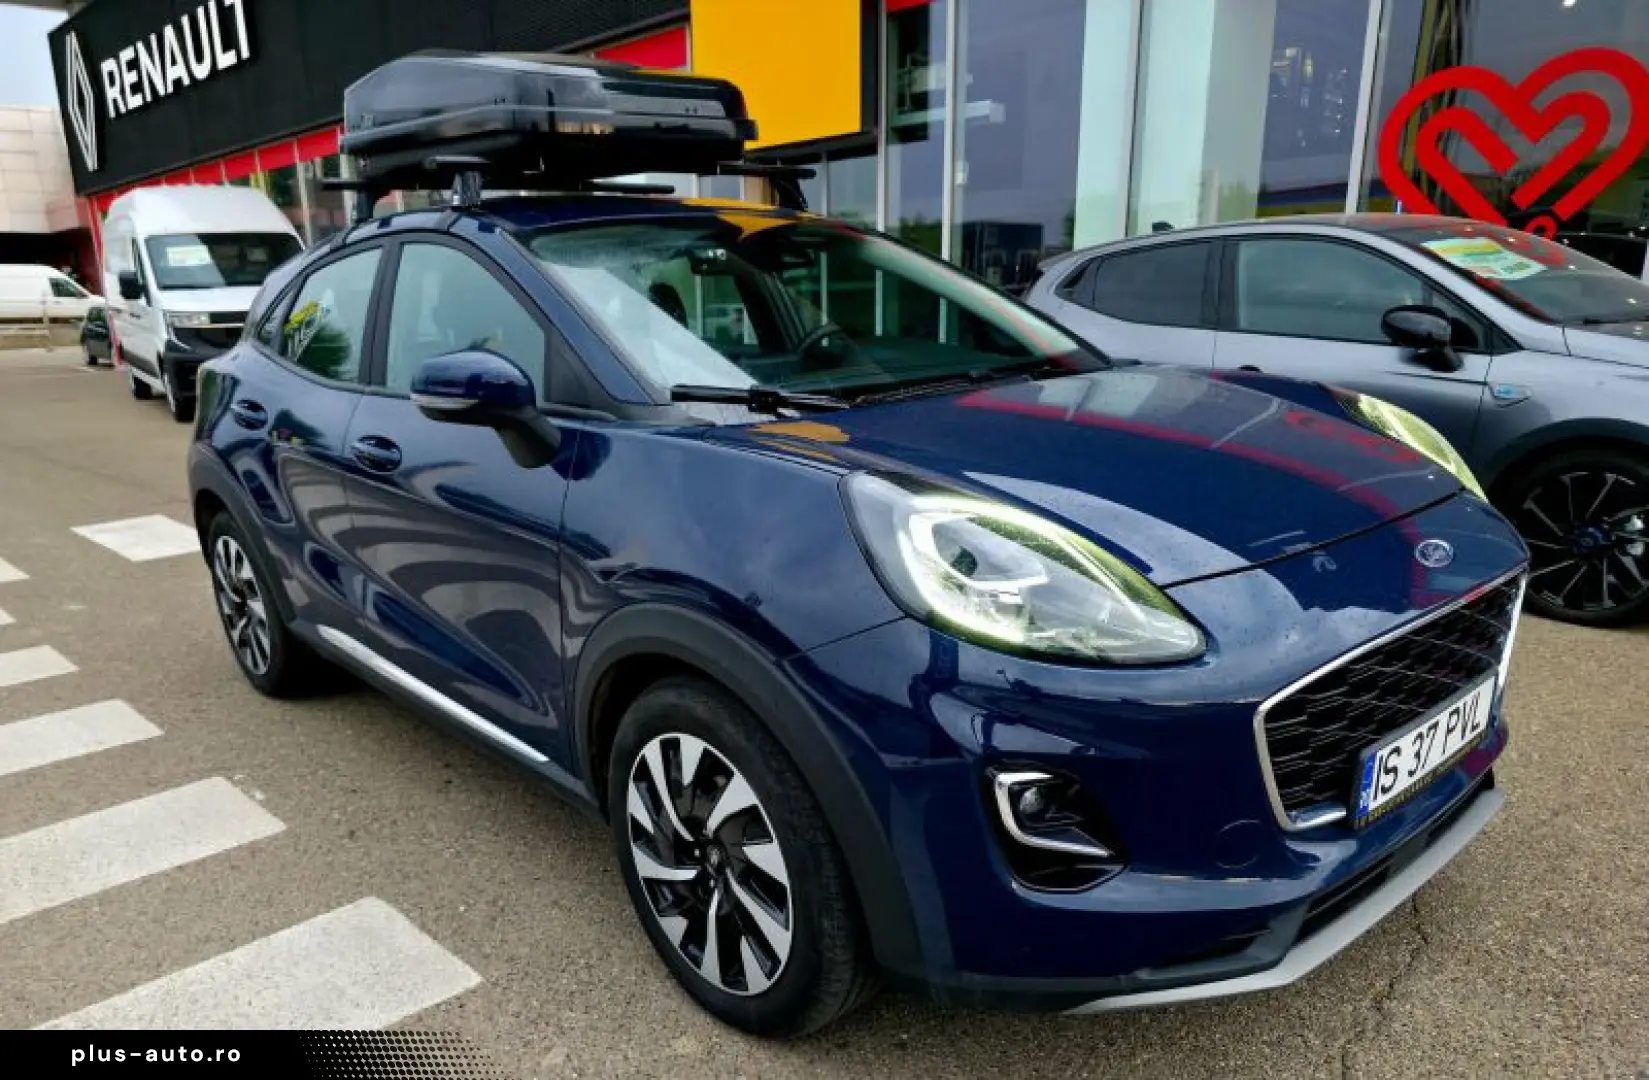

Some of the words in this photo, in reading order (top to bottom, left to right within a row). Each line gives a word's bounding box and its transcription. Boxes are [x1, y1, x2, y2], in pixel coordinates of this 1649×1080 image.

[101, 0, 250, 119] RENAULT
[1374, 746, 1402, 801] IS
[1408, 720, 1439, 778] 37
[1442, 691, 1481, 756] PVL
